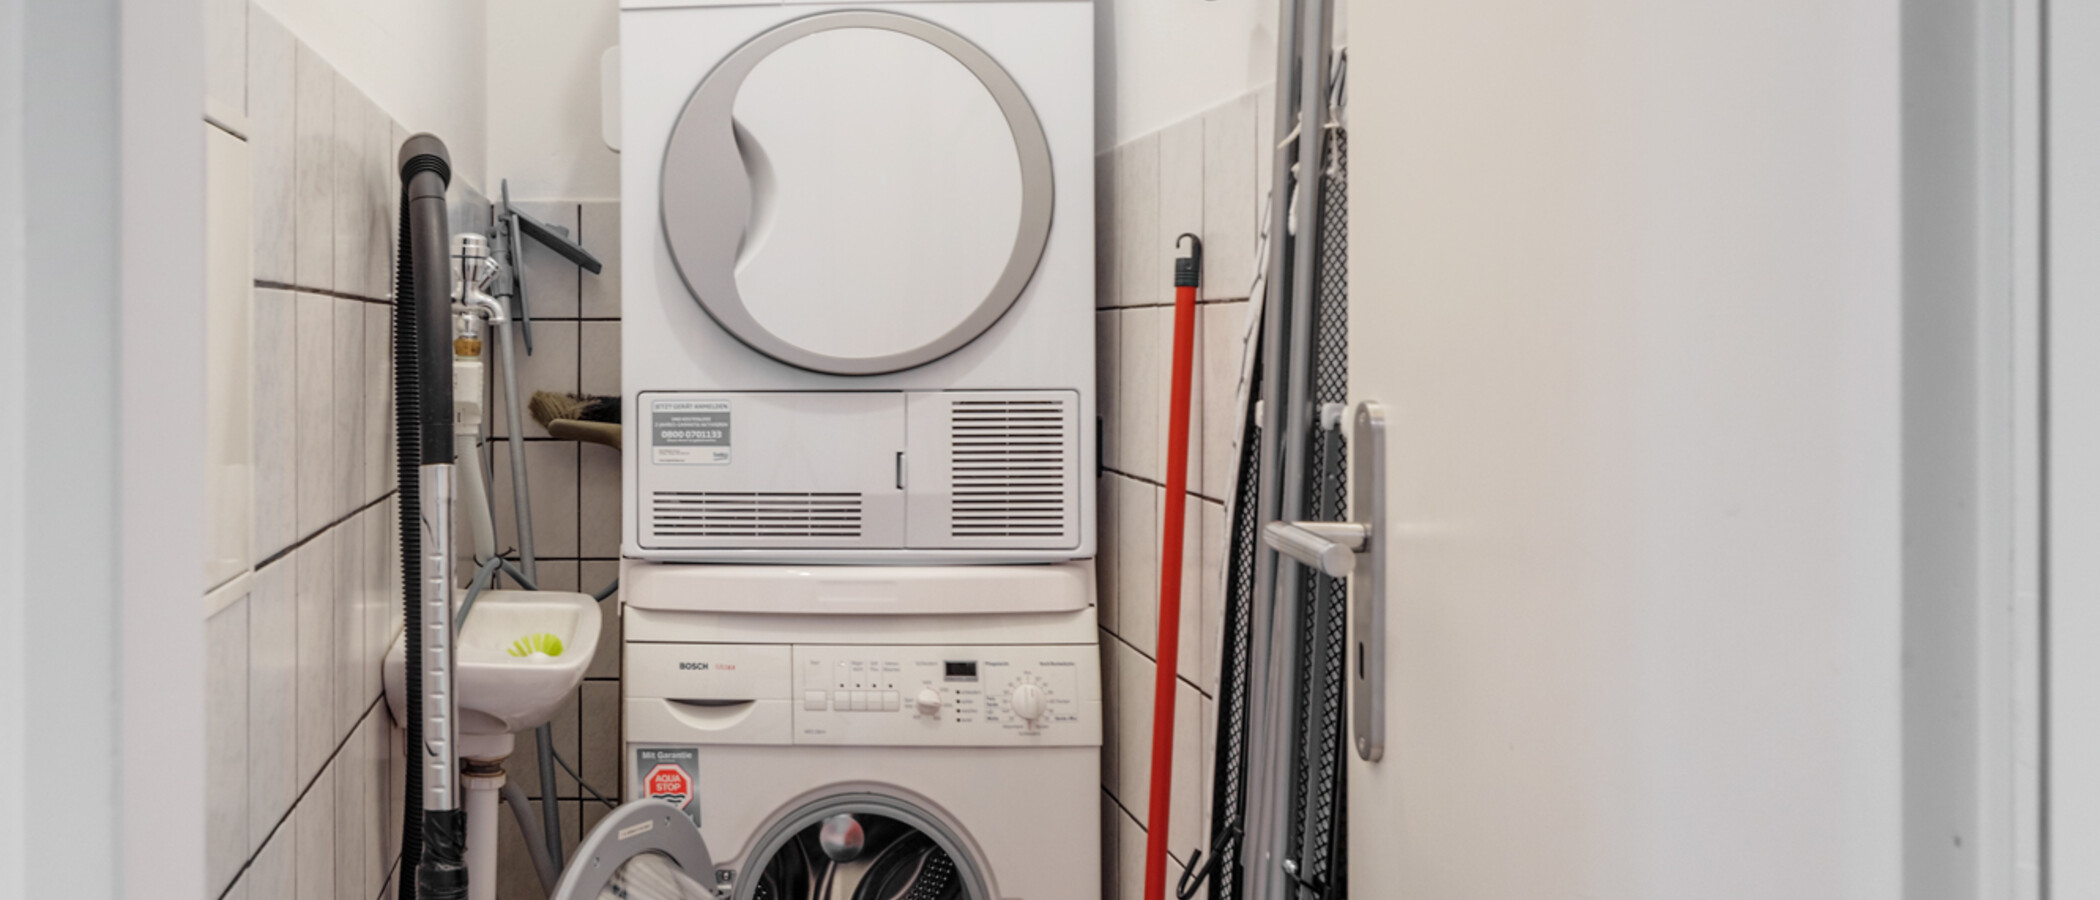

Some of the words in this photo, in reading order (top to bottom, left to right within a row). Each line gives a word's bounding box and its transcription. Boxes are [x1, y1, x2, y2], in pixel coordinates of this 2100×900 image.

[679, 662, 709, 670] BOSCH
[642, 751, 656, 759] Mit
[657, 751, 693, 759] Garantie
[655, 774, 682, 782] AQUA
[656, 783, 682, 791] STOP
